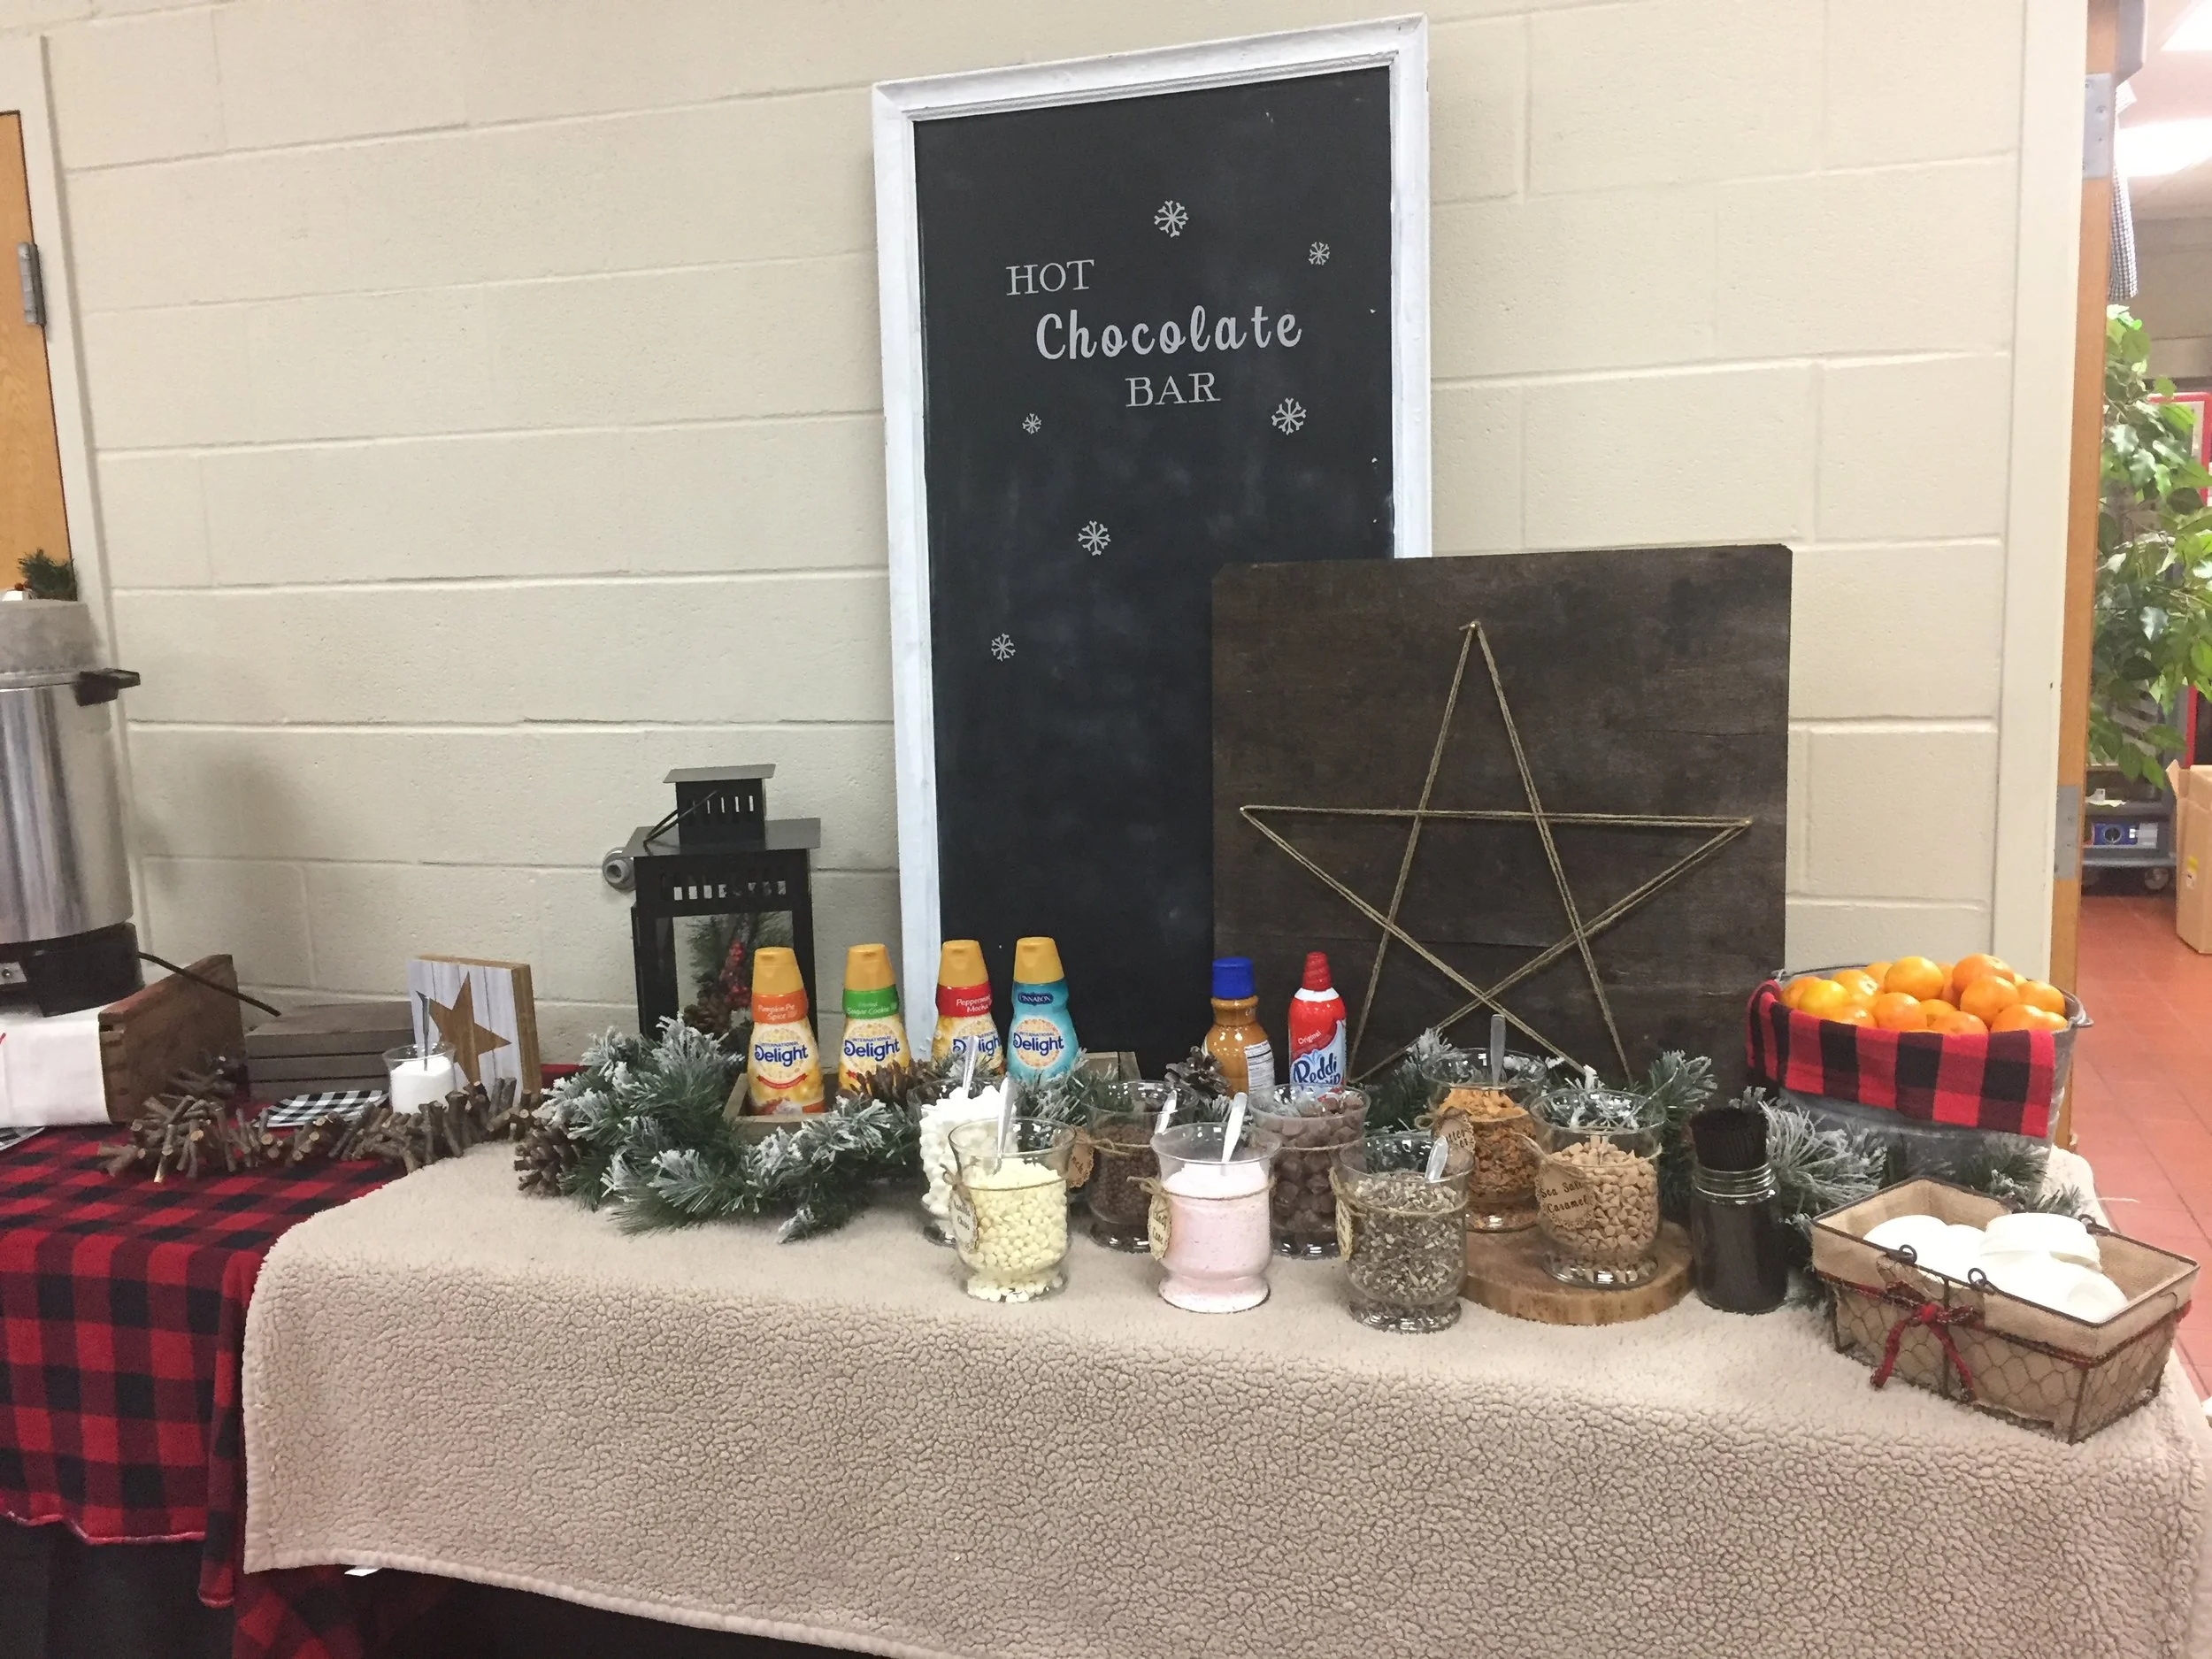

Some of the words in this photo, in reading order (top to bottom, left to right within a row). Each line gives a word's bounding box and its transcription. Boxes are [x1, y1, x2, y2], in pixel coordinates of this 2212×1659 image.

[1006, 259, 1094, 296] HOT
[1036, 305, 1302, 360] Chocolate
[1125, 372, 1221, 407] BAR
[1013, 1032, 1064, 1056] Delight
[1298, 1029, 1322, 1045] Original
[754, 1044, 809, 1067] Delight
[843, 1038, 901, 1062] Delight
[1293, 1052, 1337, 1085] Reddi
[1540, 1187, 1558, 1199] Sea
[1547, 1194, 1590, 1213] Caramel
